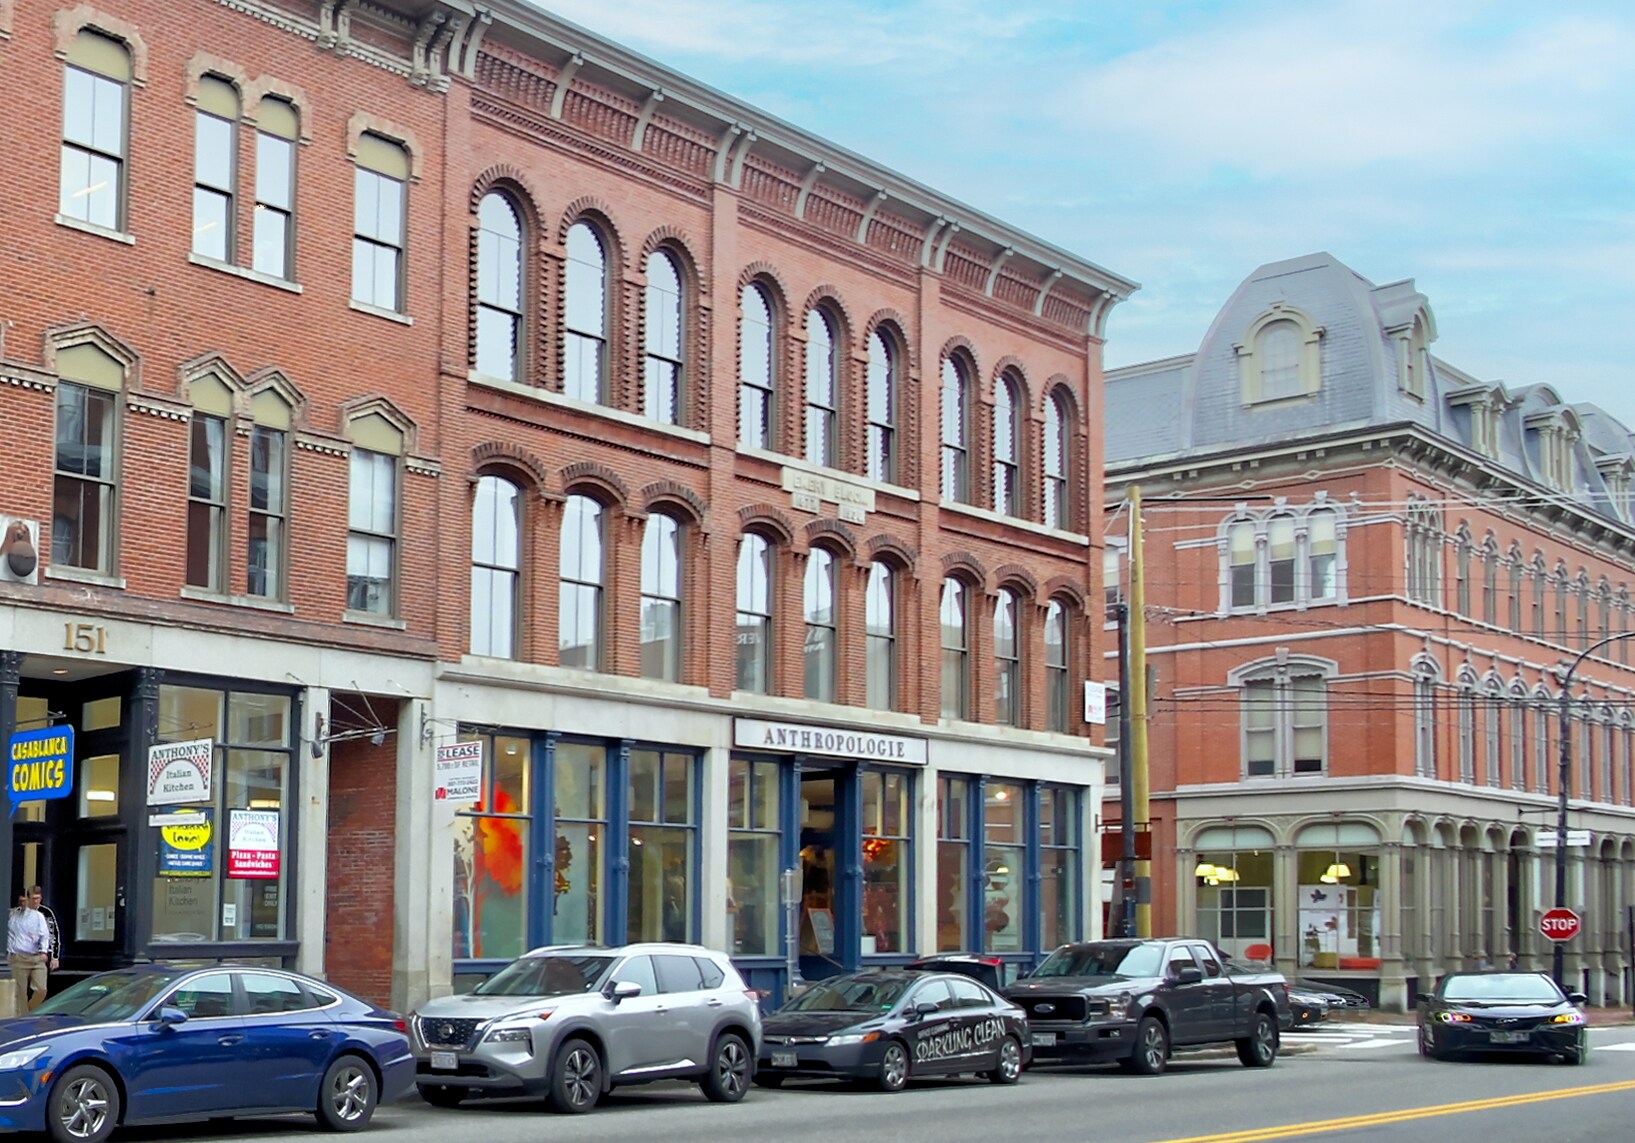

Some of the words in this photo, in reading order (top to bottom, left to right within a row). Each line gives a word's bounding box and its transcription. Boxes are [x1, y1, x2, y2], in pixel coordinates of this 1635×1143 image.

[64, 622, 107, 654] 151
[12, 737, 67, 760] CASABLANCA
[764, 727, 905, 758] ANTHROPOLOGIE
[152, 744, 209, 760] ANTHONY'S
[446, 745, 480, 758] LEASE
[12, 759, 65, 791] COMICS
[166, 769, 192, 779] Italian
[163, 783, 194, 793] Kitchen
[447, 786, 478, 795] MALONE
[232, 813, 277, 822] ANTHONY'S
[231, 851, 251, 859] Pizza
[257, 851, 276, 860] Pasta
[234, 860, 273, 868] Sandwiches
[1542, 918, 1577, 931] STOP
[974, 1018, 1006, 1045] CLEAN
